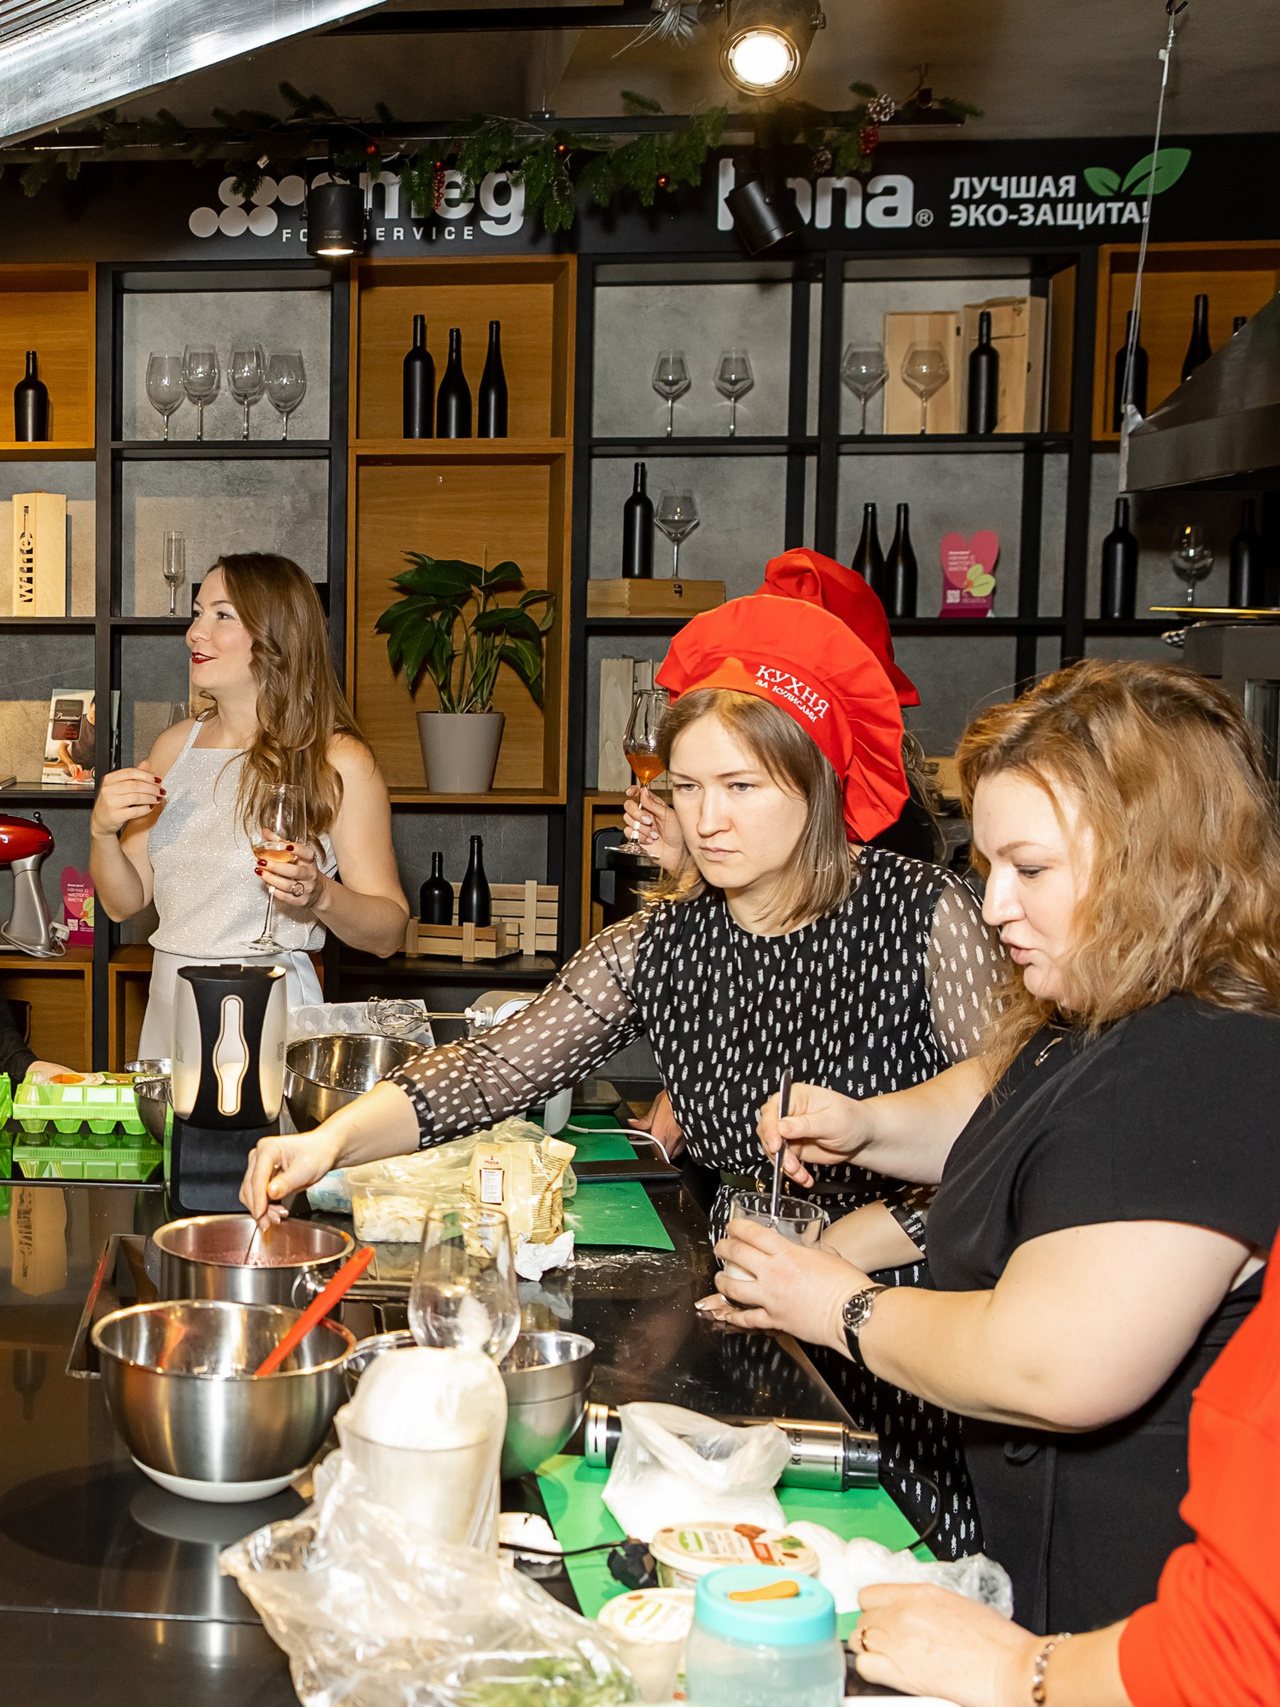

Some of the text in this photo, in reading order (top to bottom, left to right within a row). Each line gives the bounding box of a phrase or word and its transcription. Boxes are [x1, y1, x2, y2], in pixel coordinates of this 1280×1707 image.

[949, 175, 1077, 200] ЛУЧШАЯ
[949, 201, 1149, 231] ЭКО-ЗАЩИТА!
[755, 665, 830, 719] КУХНЯ
[755, 679, 818, 723] ЗА КУЛИСАМИ
